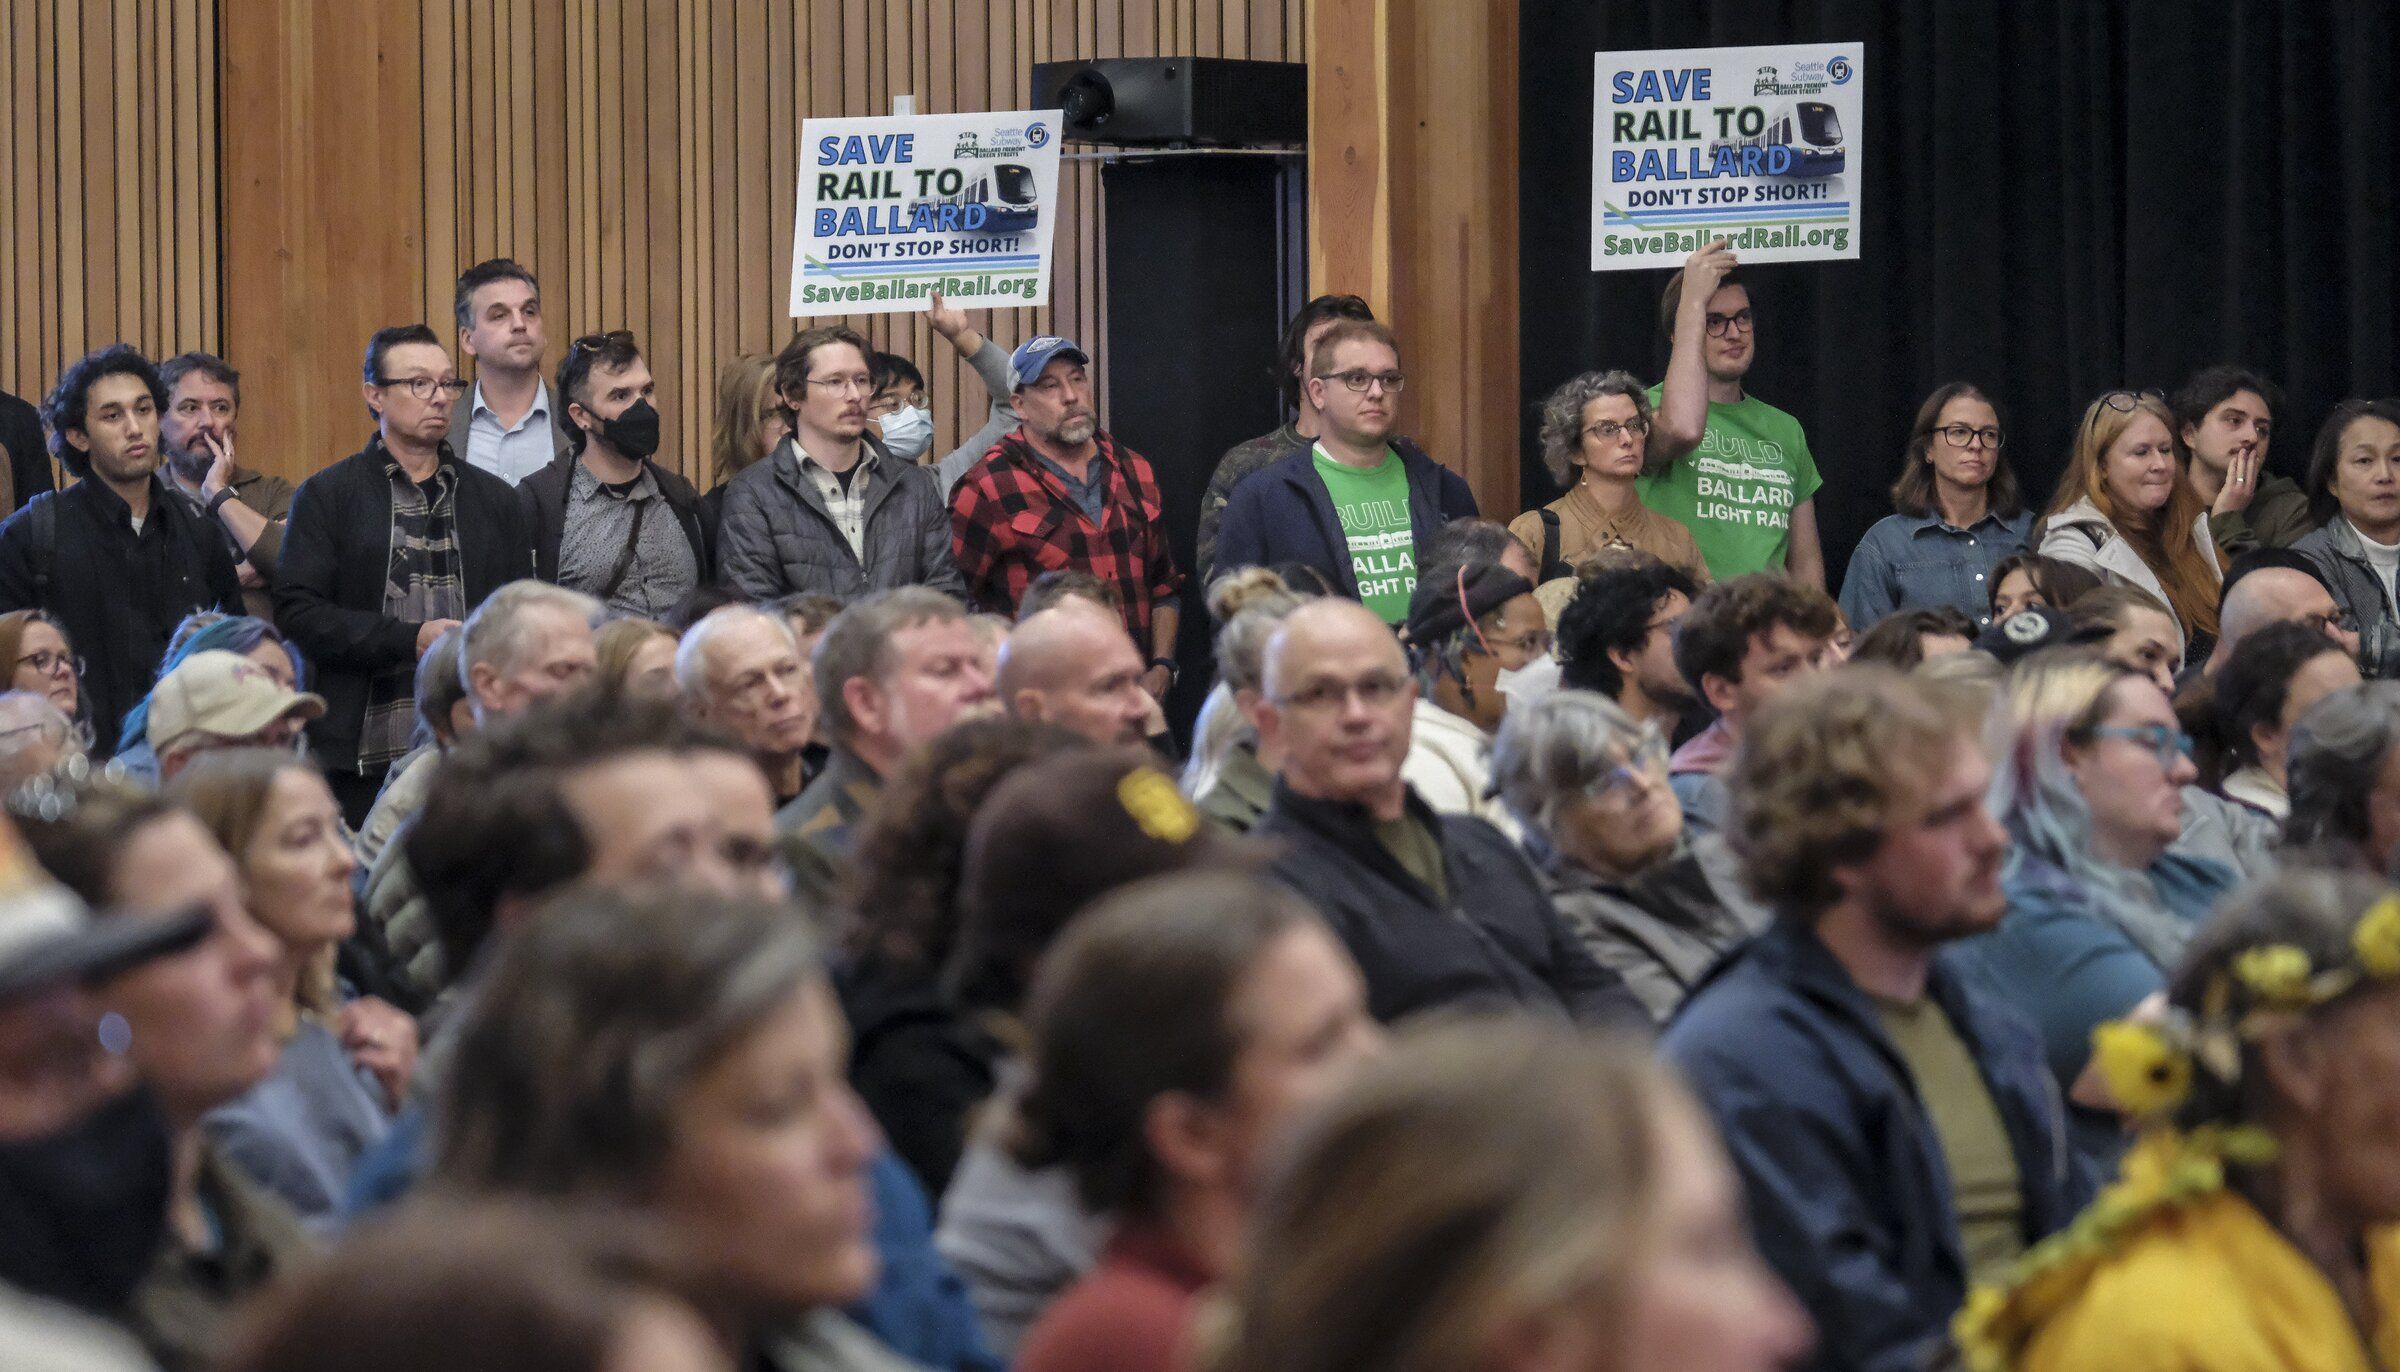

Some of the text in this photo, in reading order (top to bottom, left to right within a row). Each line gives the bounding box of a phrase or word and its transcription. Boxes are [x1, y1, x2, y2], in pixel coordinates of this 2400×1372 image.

[1791, 72, 1824, 82] Subway
[1795, 62, 1824, 71] Seattle
[1612, 68, 1711, 104] SAVE
[994, 128, 1023, 137] Seattle
[1613, 106, 1765, 143] RAIL TO
[818, 134, 914, 166] SAVE
[990, 137, 1022, 147] Subway
[1612, 145, 1792, 183] BALLARD
[817, 168, 963, 200] RAIL TO
[1628, 183, 1827, 207] DON'T STOP SHORT!
[814, 203, 987, 237] BALLARD
[828, 238, 1019, 259] DON'T STOP SHORT!
[802, 276, 1038, 304] SaveBallardRail.org
[1699, 428, 1783, 464] BULD
[1697, 477, 1794, 507] BALLARD
[1697, 501, 1751, 525] LIGHT
[1353, 552, 1415, 575] ALLA
[1358, 577, 1399, 597] GHT
